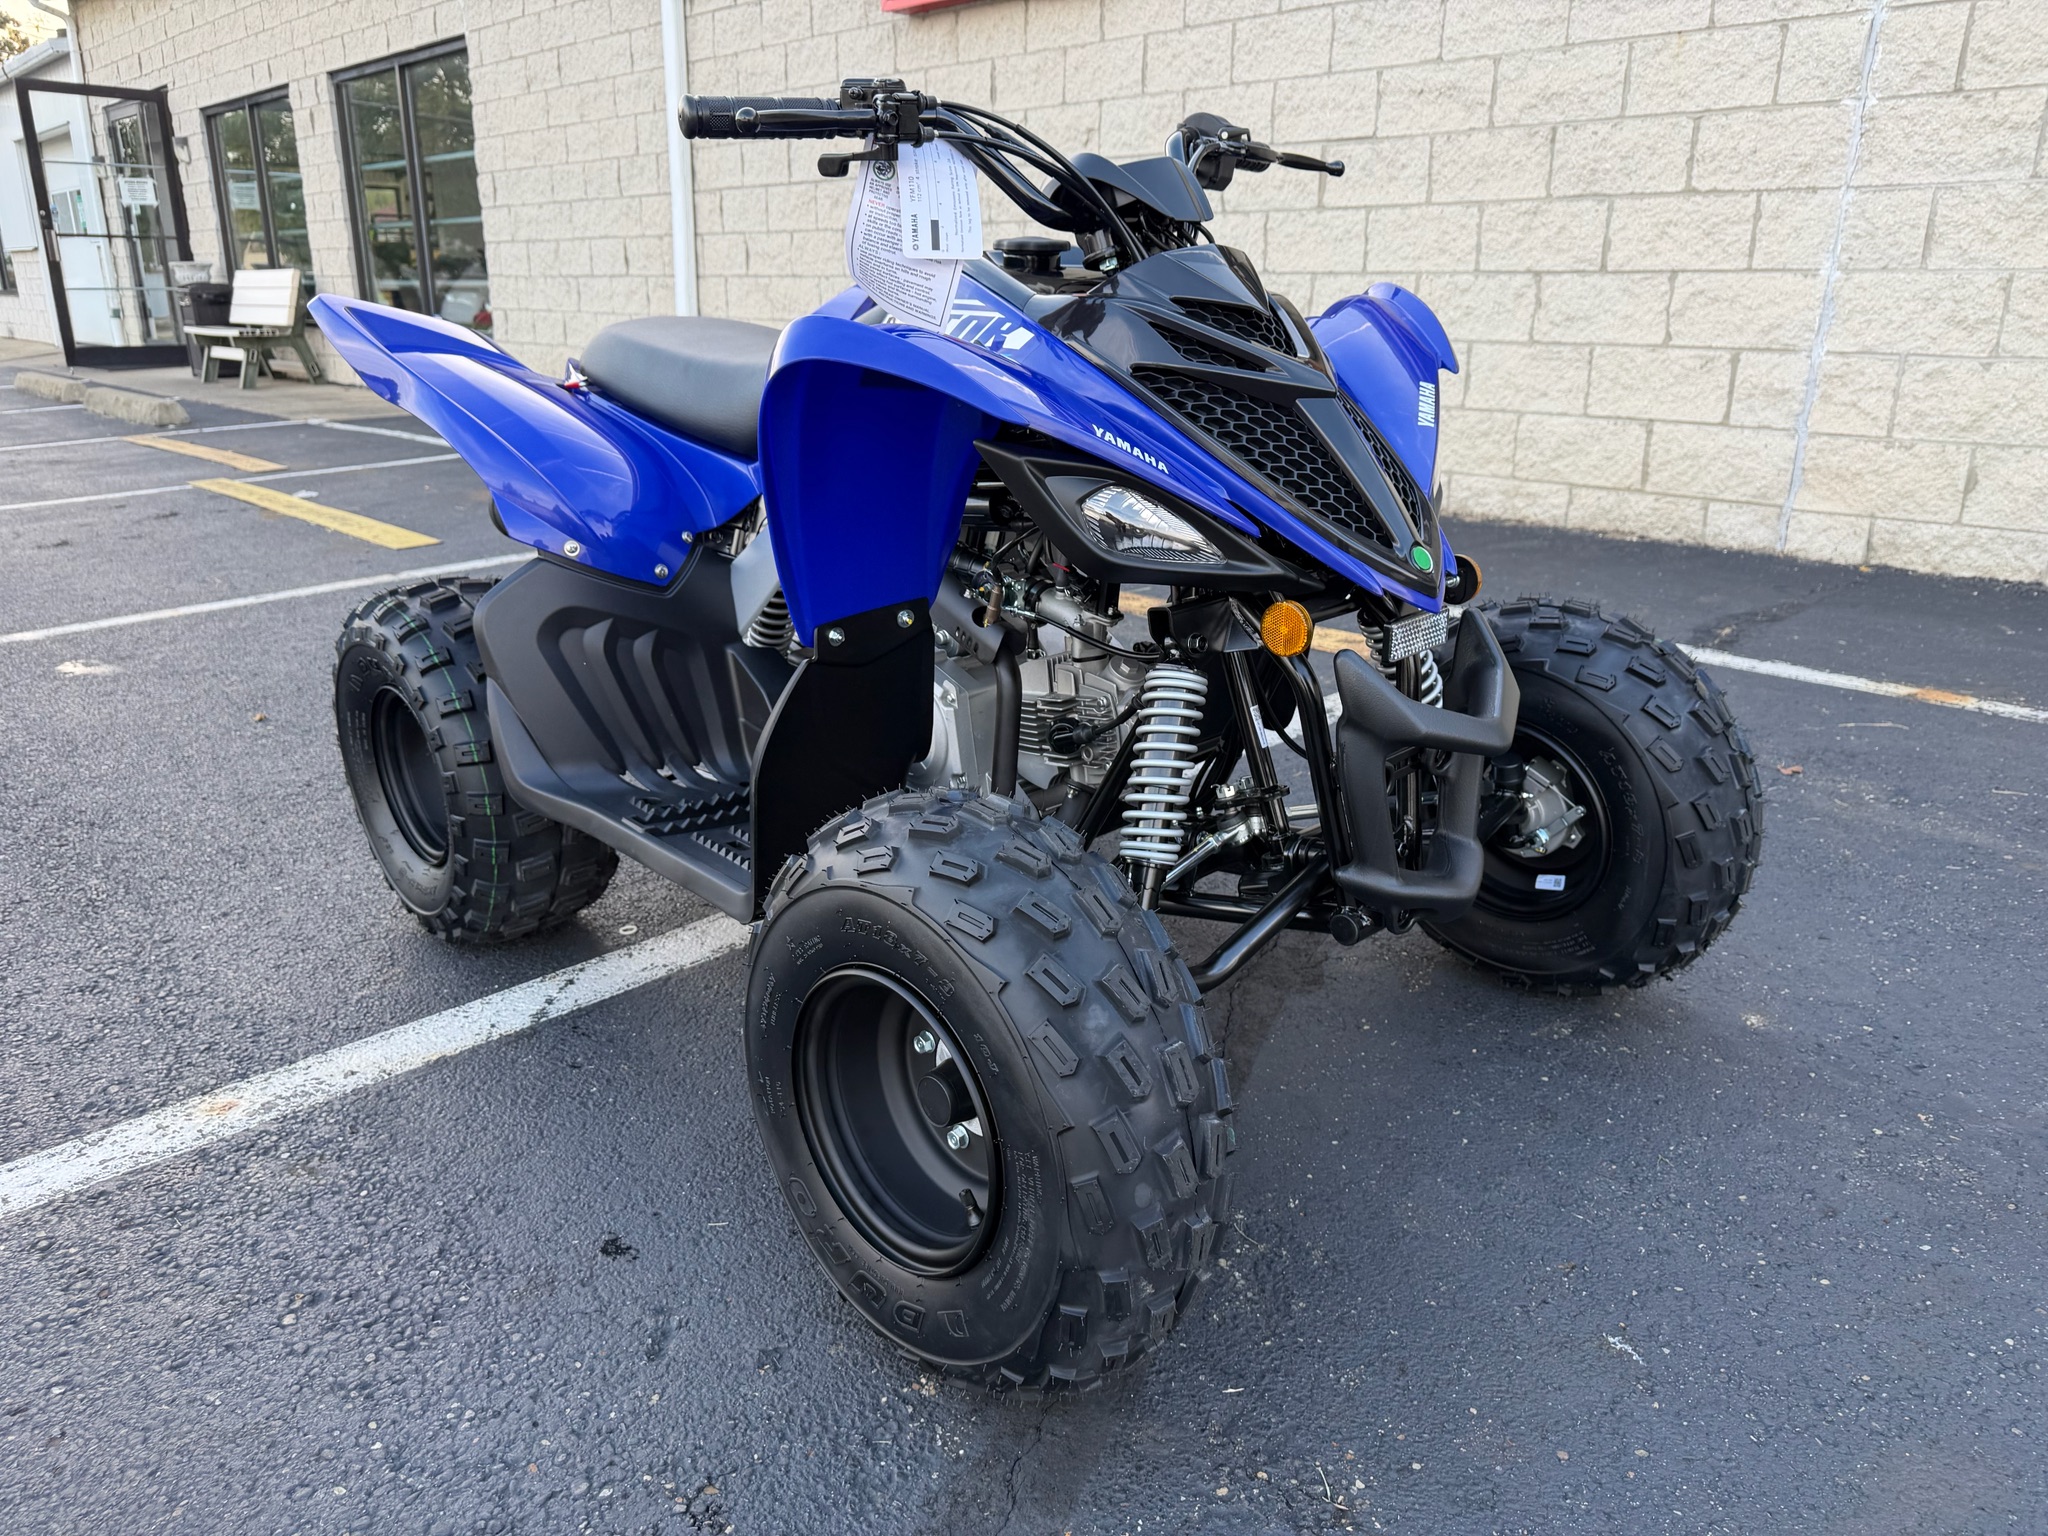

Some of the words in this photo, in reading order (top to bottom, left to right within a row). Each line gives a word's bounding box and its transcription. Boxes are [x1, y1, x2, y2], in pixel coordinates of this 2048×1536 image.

[911, 214, 919, 242] YAMAHA
[1418, 381, 1436, 427] YAMAHA
[1092, 424, 1169, 474] YAMAHA
